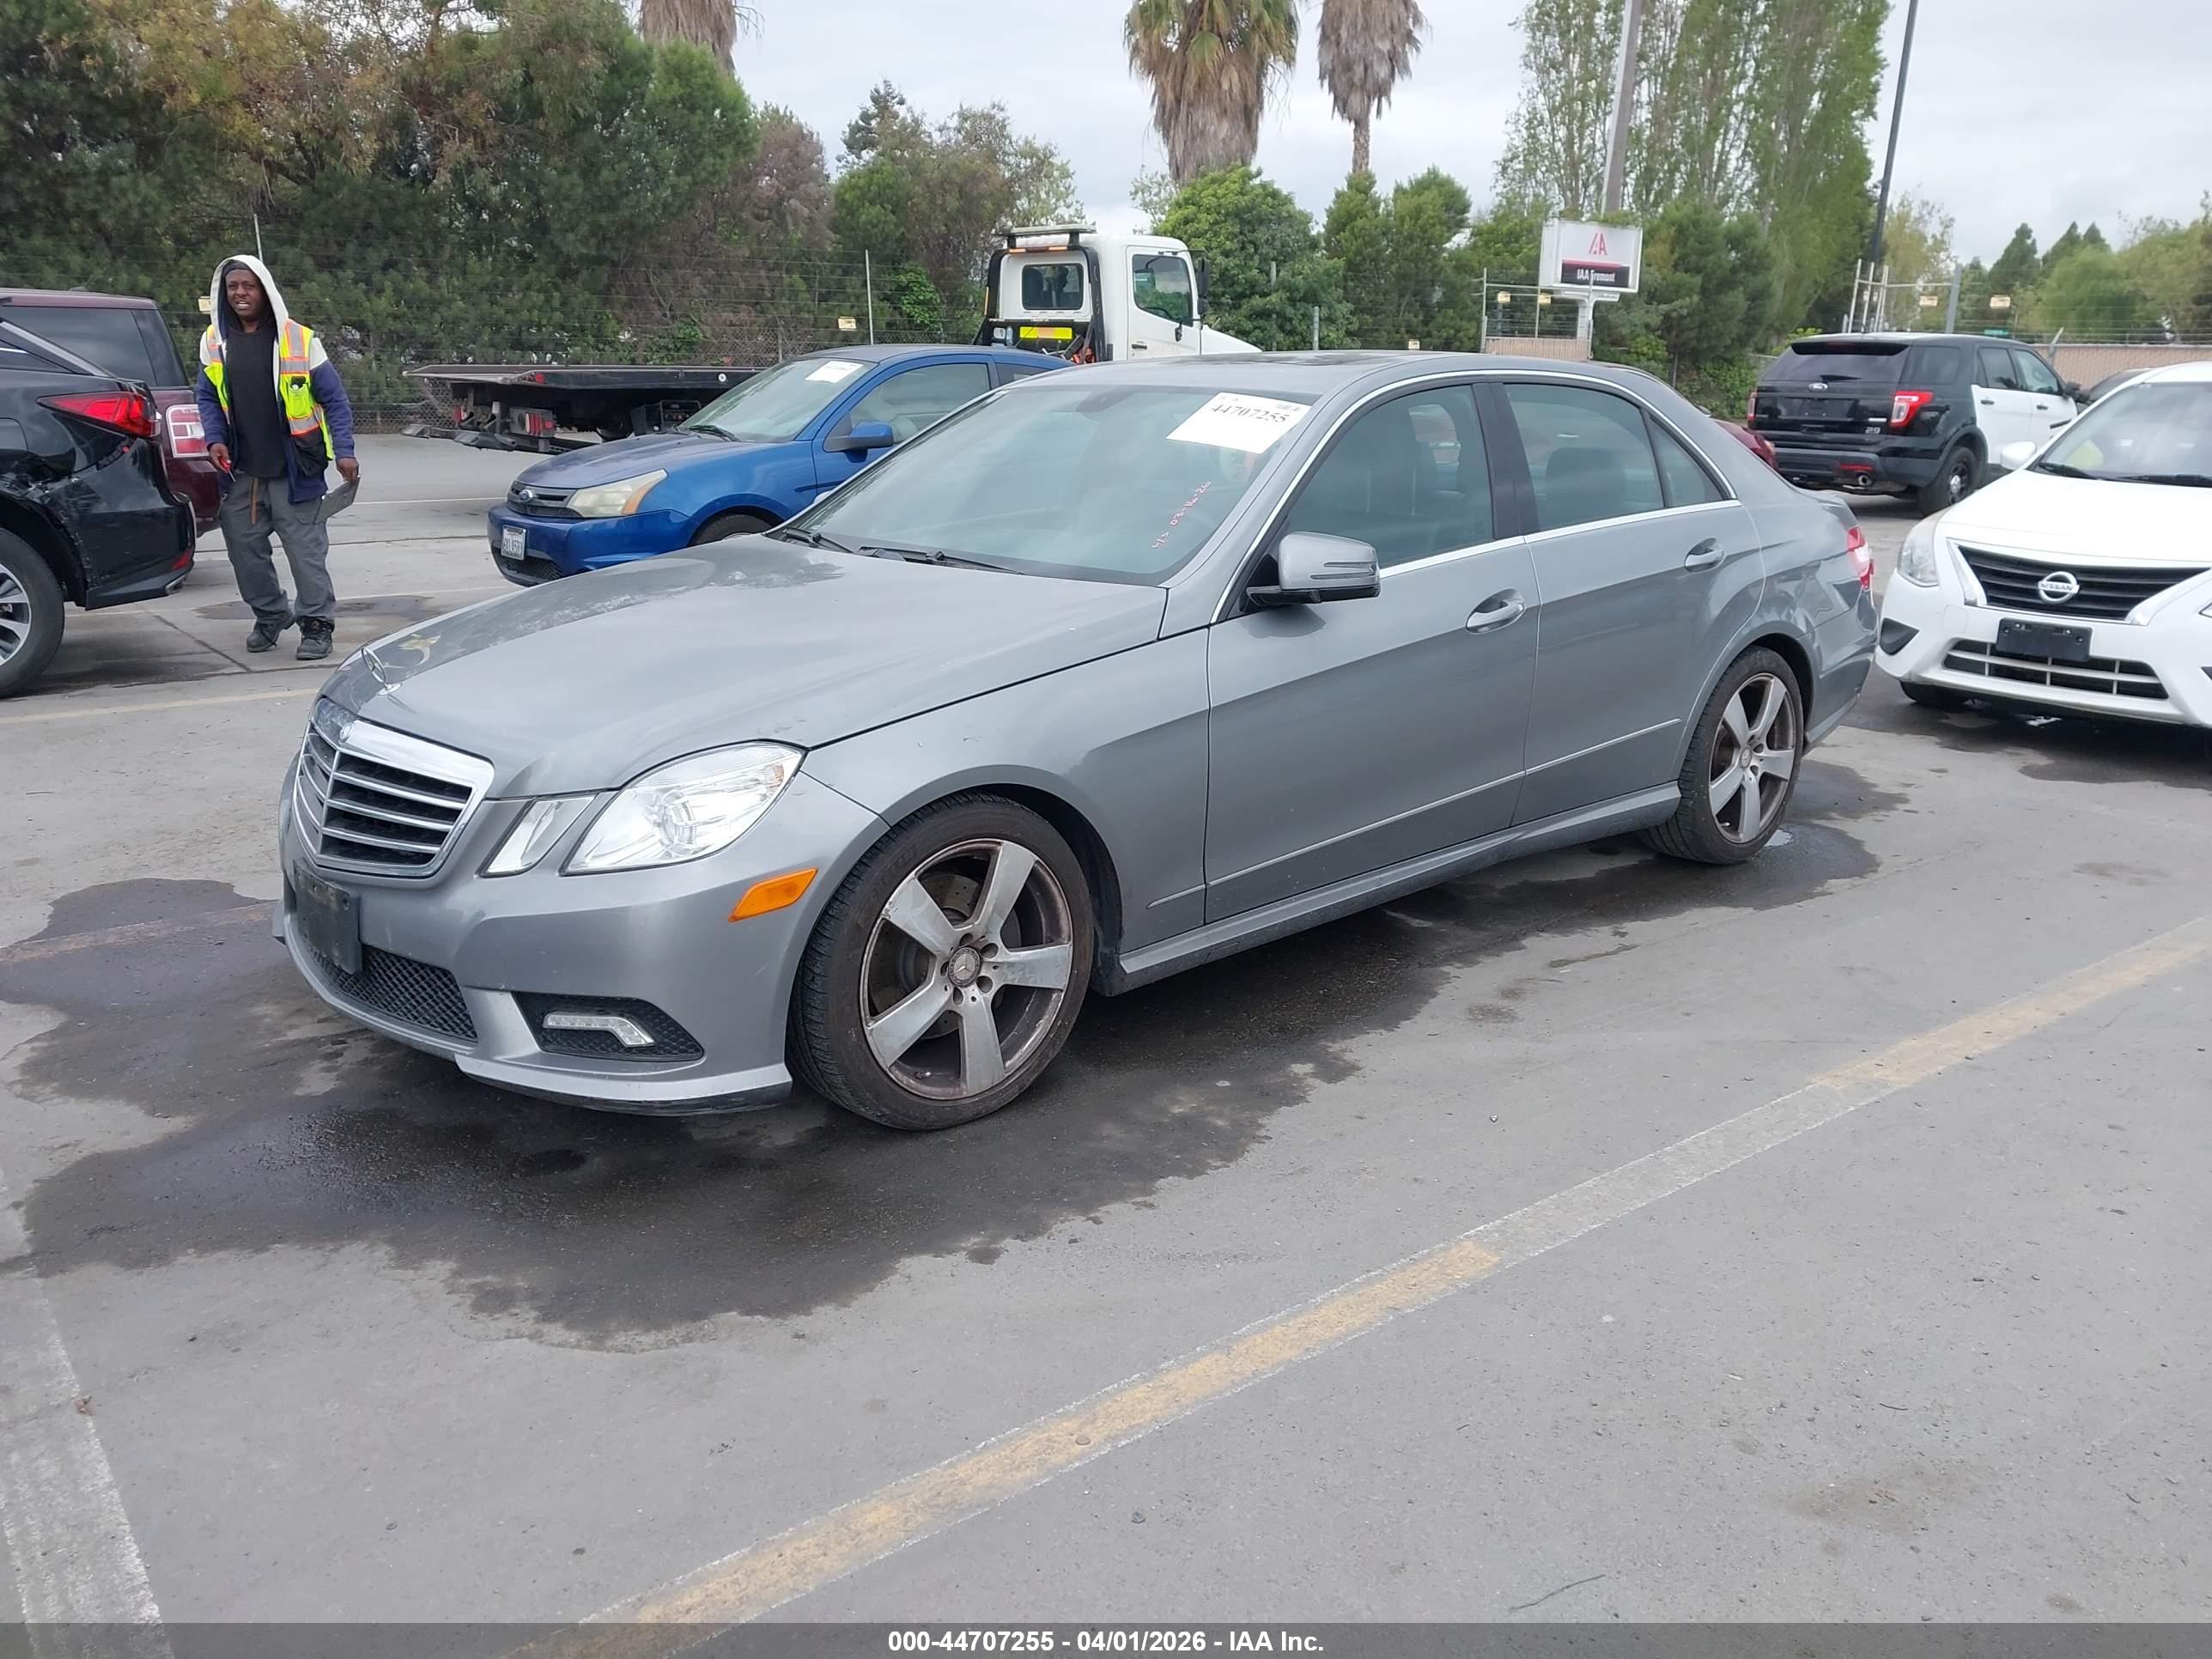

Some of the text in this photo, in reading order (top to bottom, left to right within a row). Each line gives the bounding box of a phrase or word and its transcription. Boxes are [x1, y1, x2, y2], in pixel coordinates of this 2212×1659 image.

[1577, 268, 1615, 282] IAA Fremont
[1212, 404, 1291, 422] 44707255
